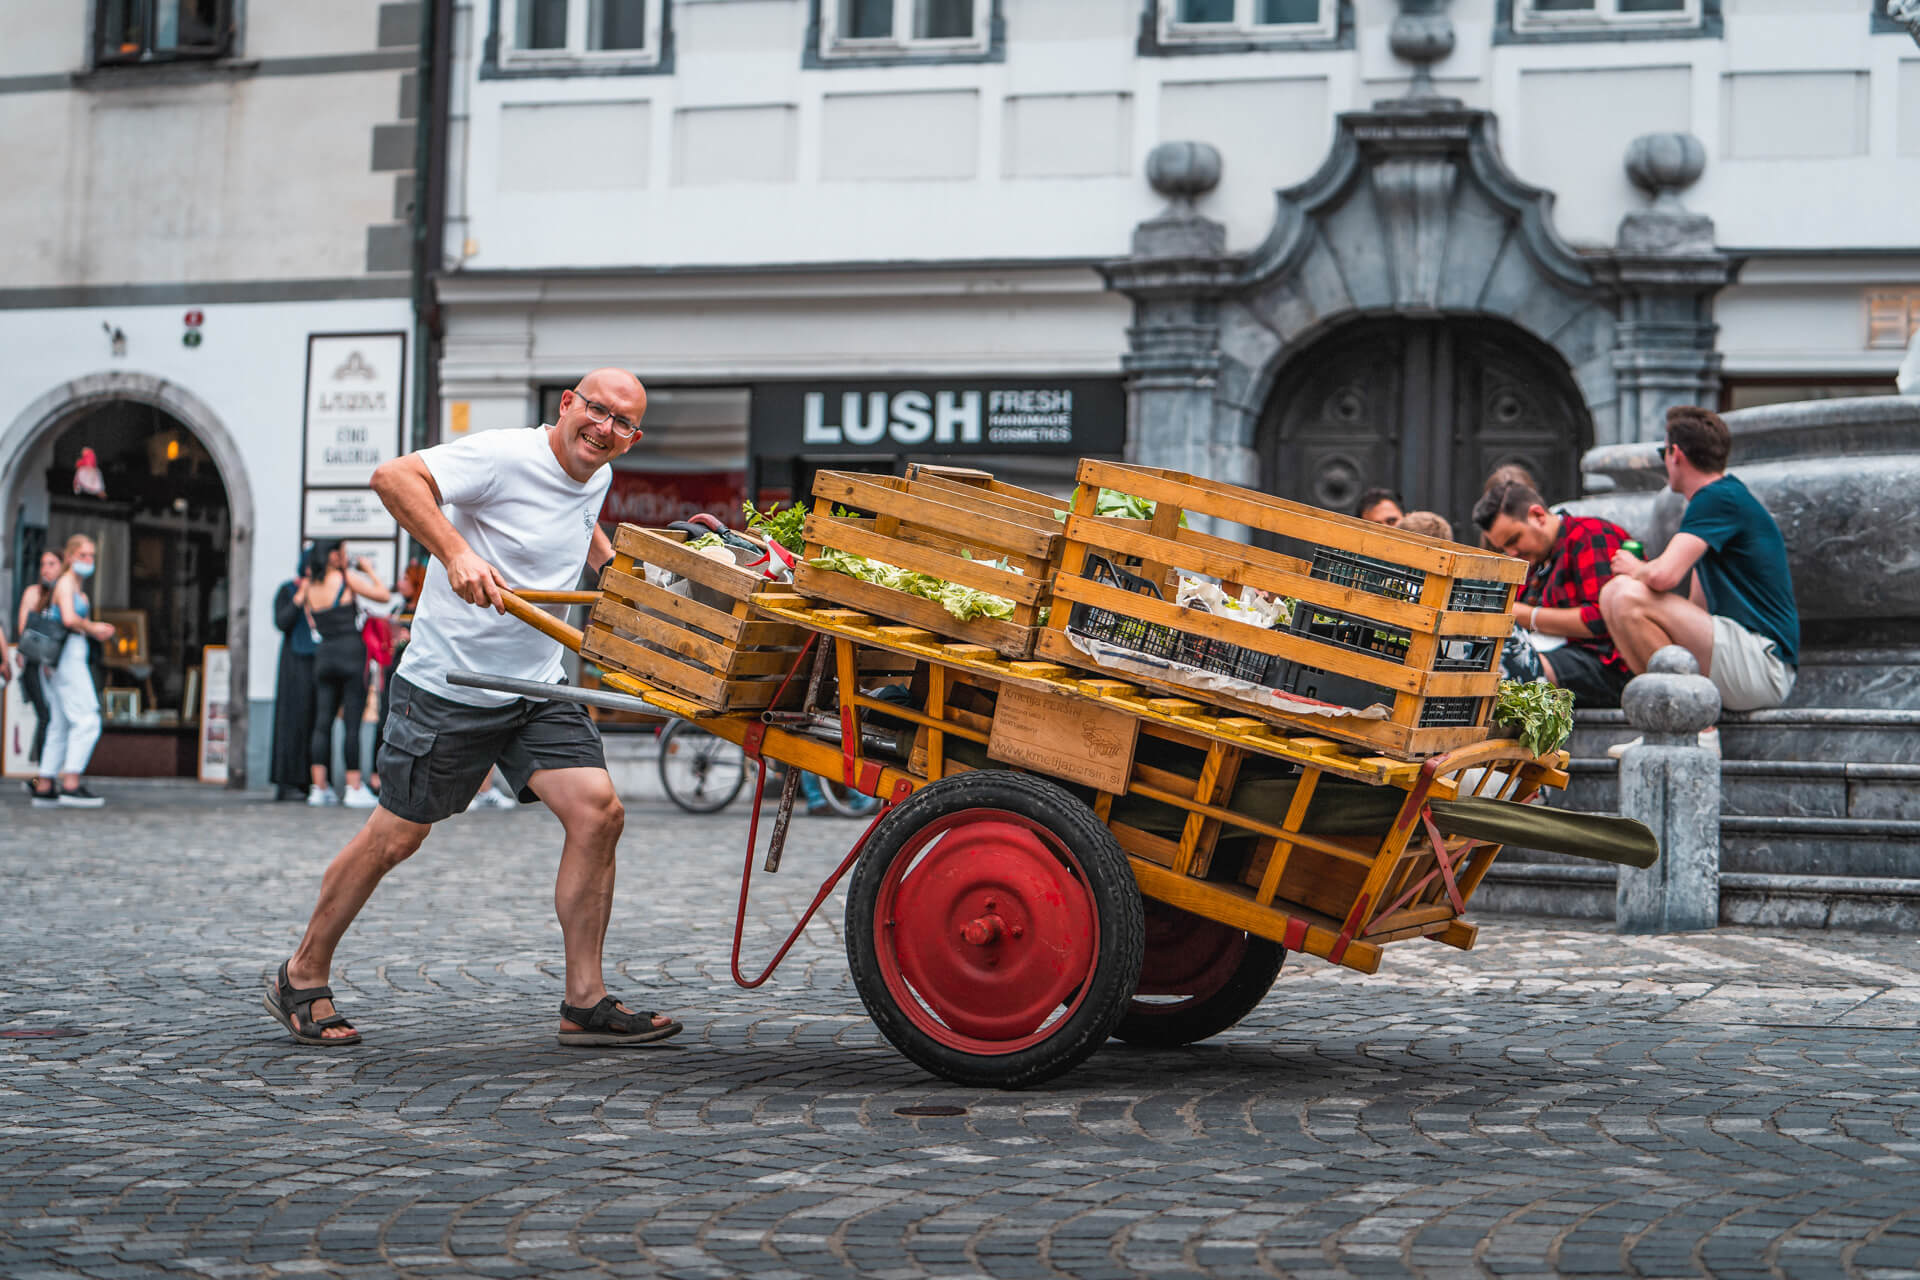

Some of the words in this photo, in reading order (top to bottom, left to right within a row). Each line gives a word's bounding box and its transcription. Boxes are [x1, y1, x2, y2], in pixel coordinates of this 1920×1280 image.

[989, 391, 1072, 411] FRESH
[803, 391, 982, 444] LUSH
[989, 413, 1072, 427] HANDMADE
[989, 427, 1072, 443] COSMETICS
[1004, 687, 1041, 707] Kmetija
[993, 742, 1120, 786] www.kmetijapersin.si
